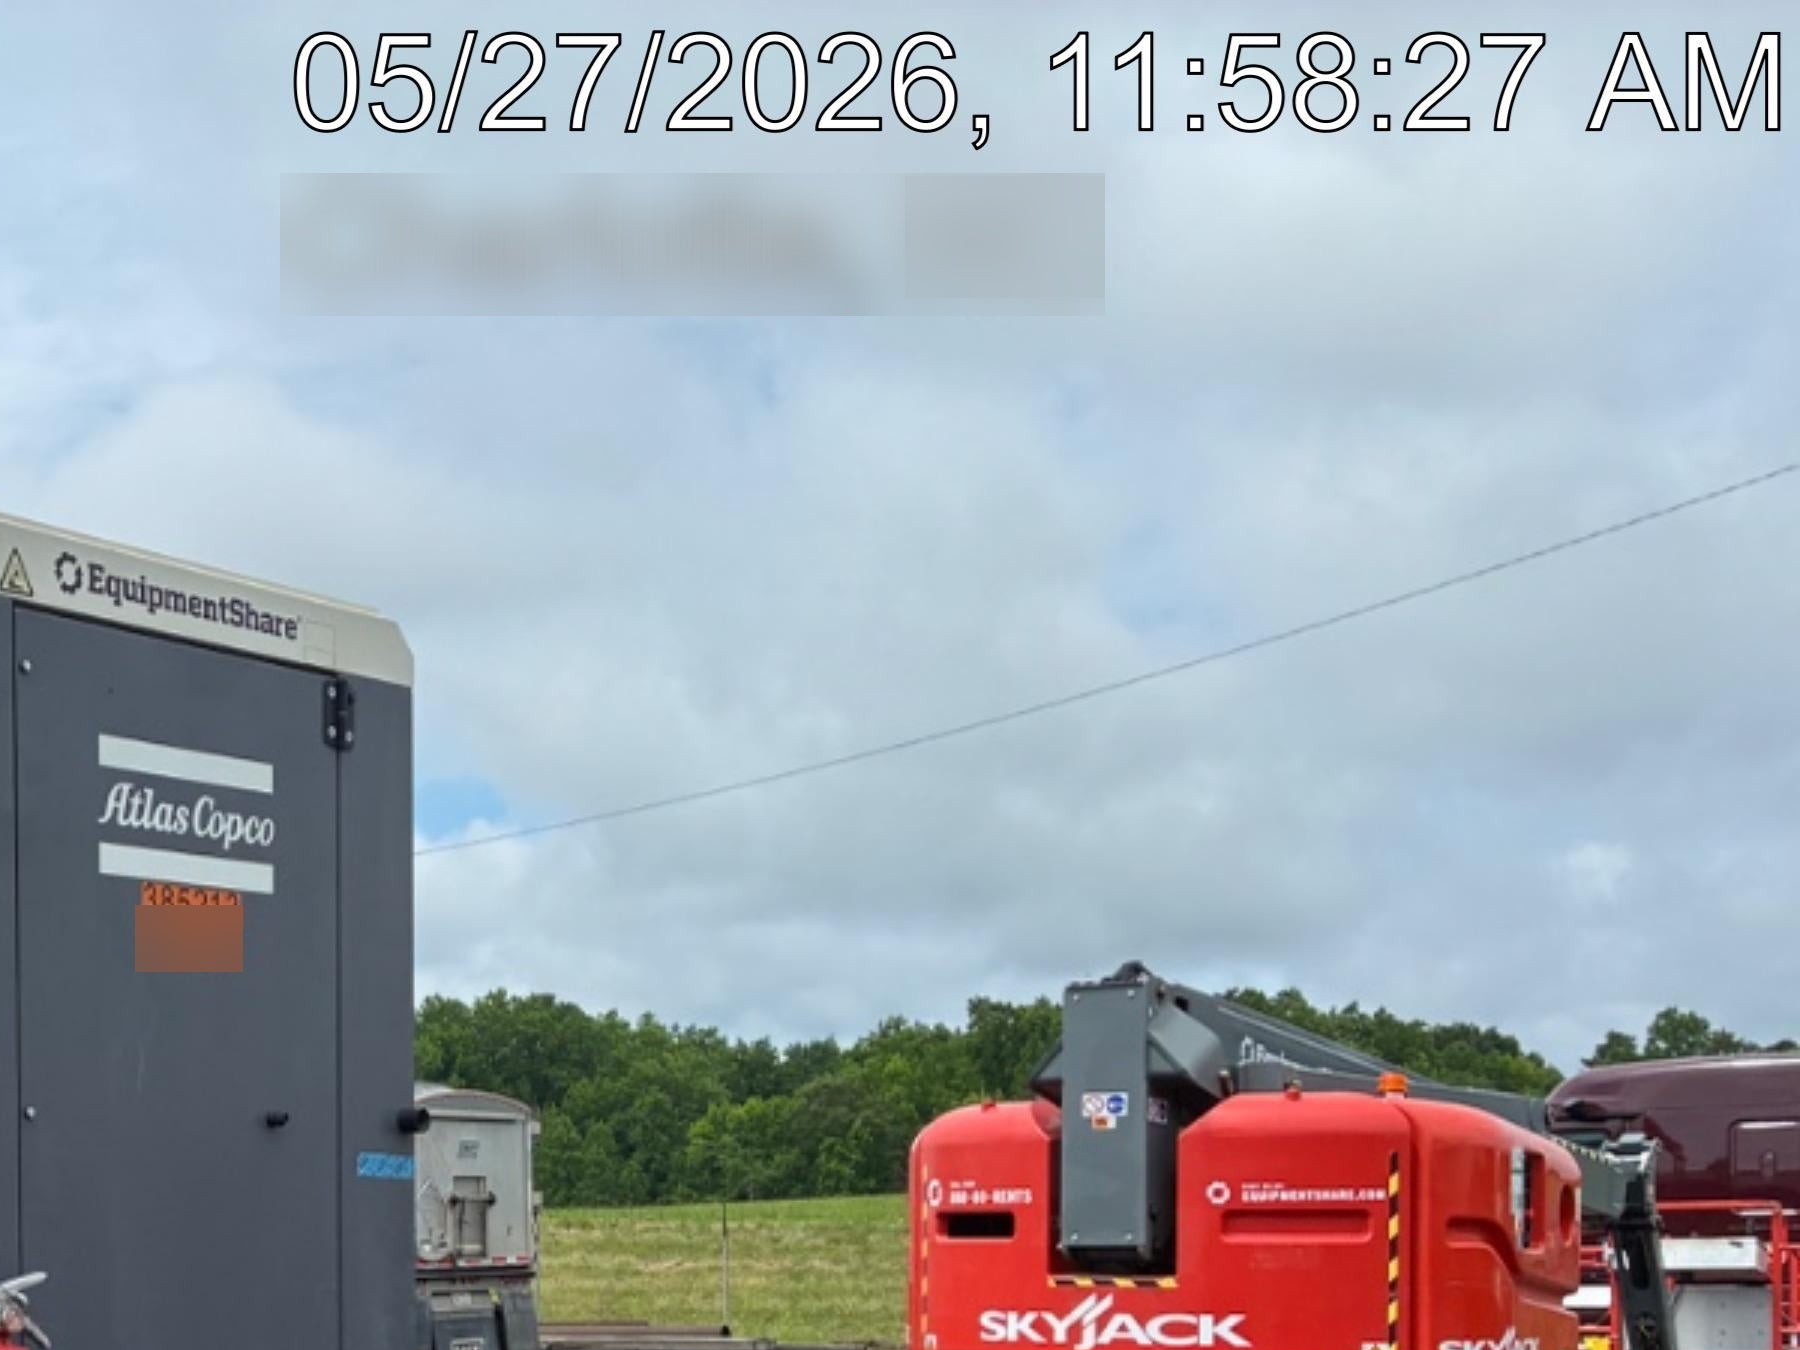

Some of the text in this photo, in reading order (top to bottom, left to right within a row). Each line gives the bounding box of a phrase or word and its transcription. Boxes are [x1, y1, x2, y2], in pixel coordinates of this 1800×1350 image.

[87, 562, 300, 640] EquipmentShare
[97, 781, 275, 851] Atlas Copco
